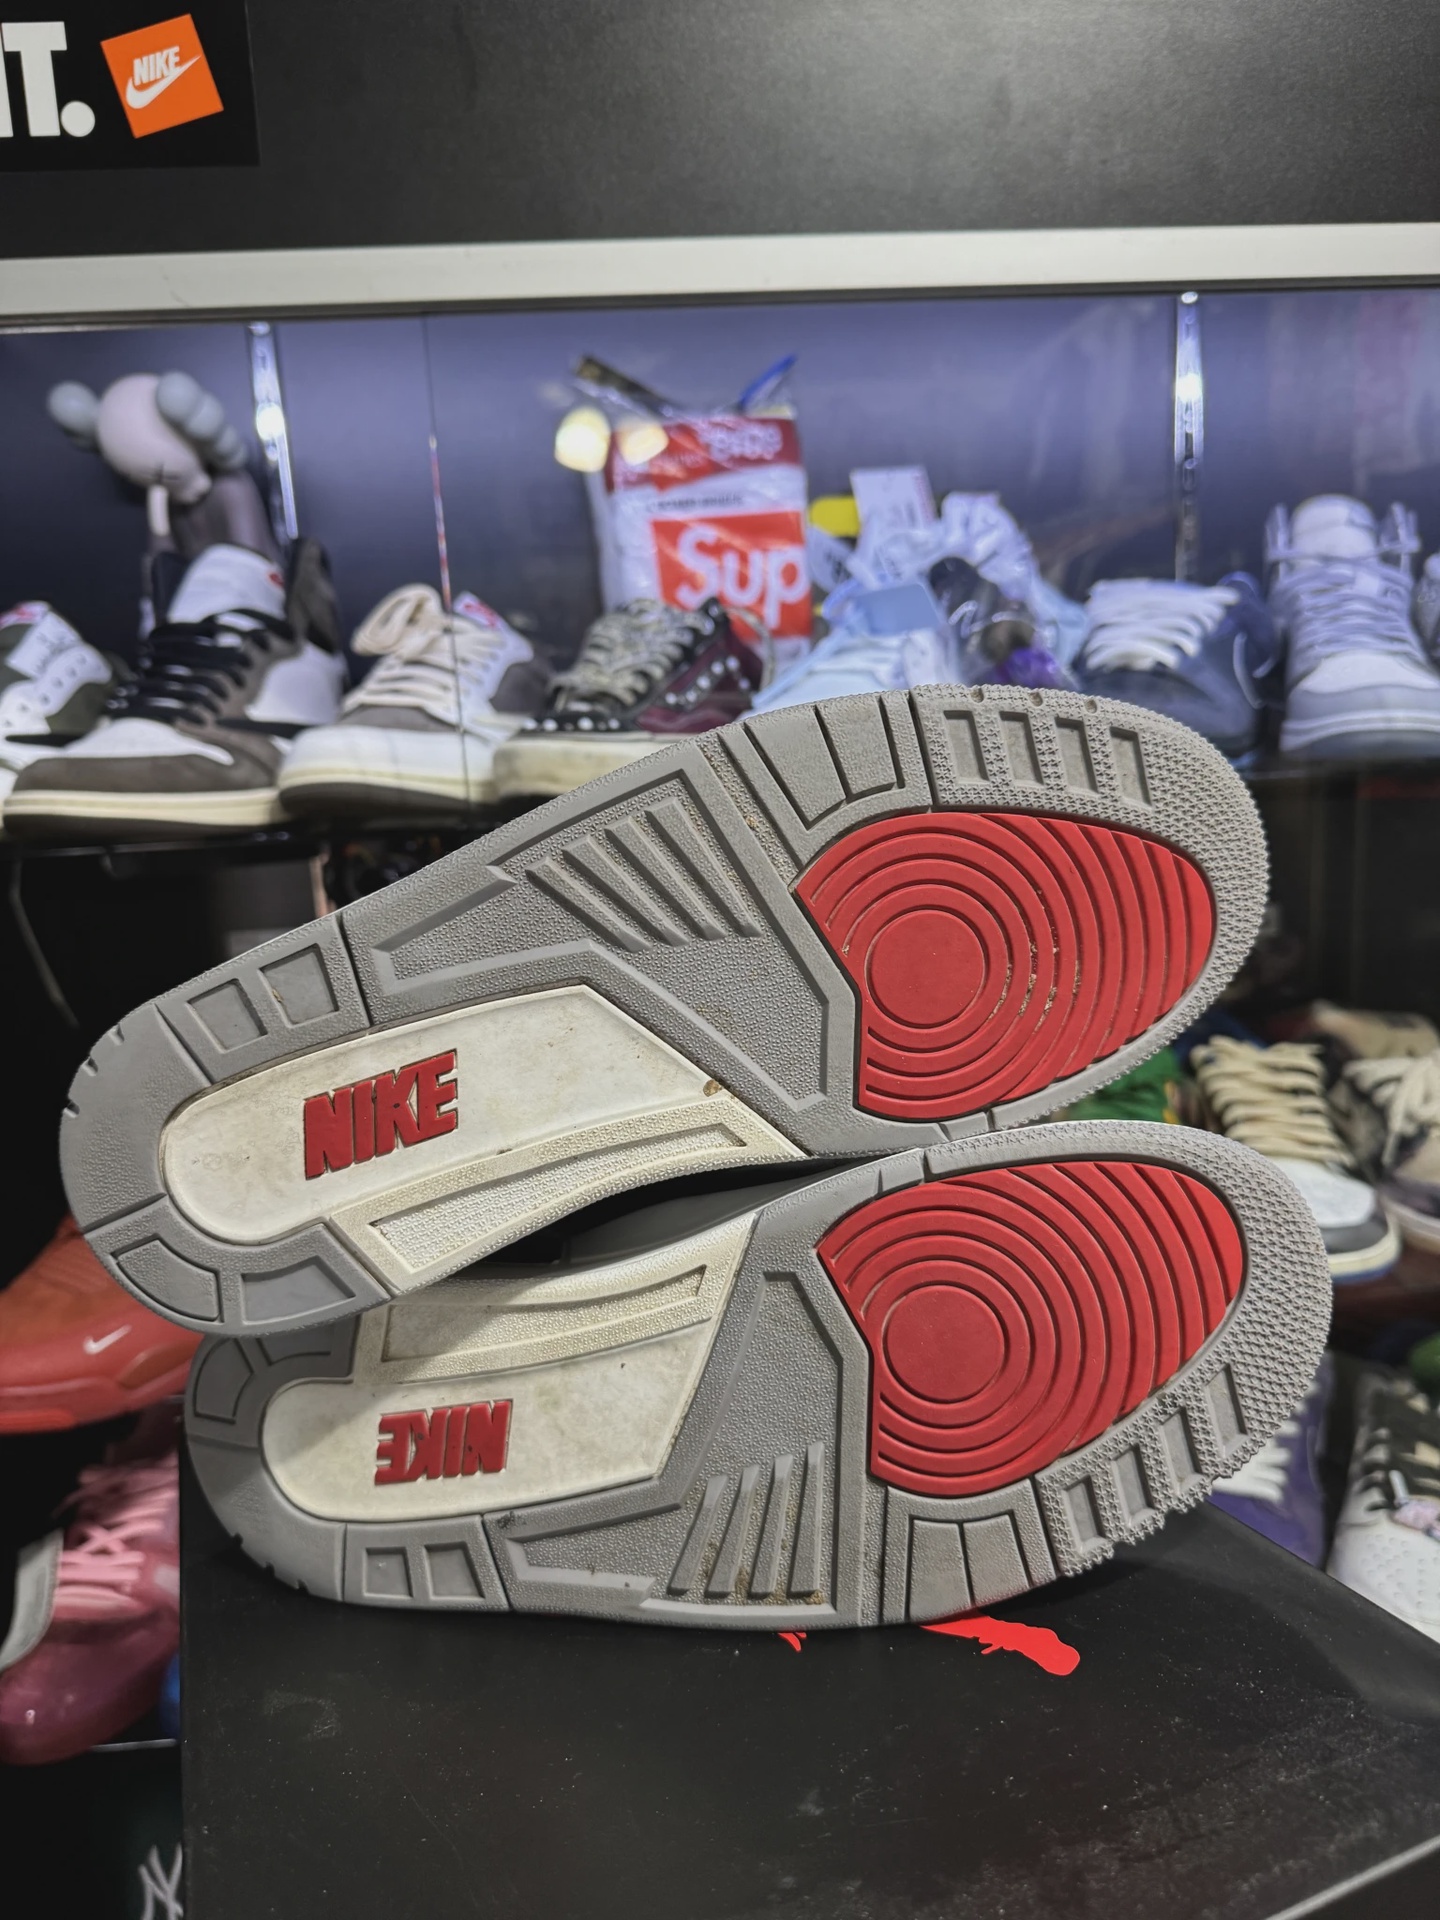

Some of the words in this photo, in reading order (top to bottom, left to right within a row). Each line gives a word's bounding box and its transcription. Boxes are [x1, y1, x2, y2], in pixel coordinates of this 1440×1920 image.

[0, 21, 96, 138] T.
[132, 45, 182, 86] NIKE
[677, 524, 805, 629] Sup
[303, 1048, 458, 1181] NIKE
[374, 1399, 513, 1486] NIKE
